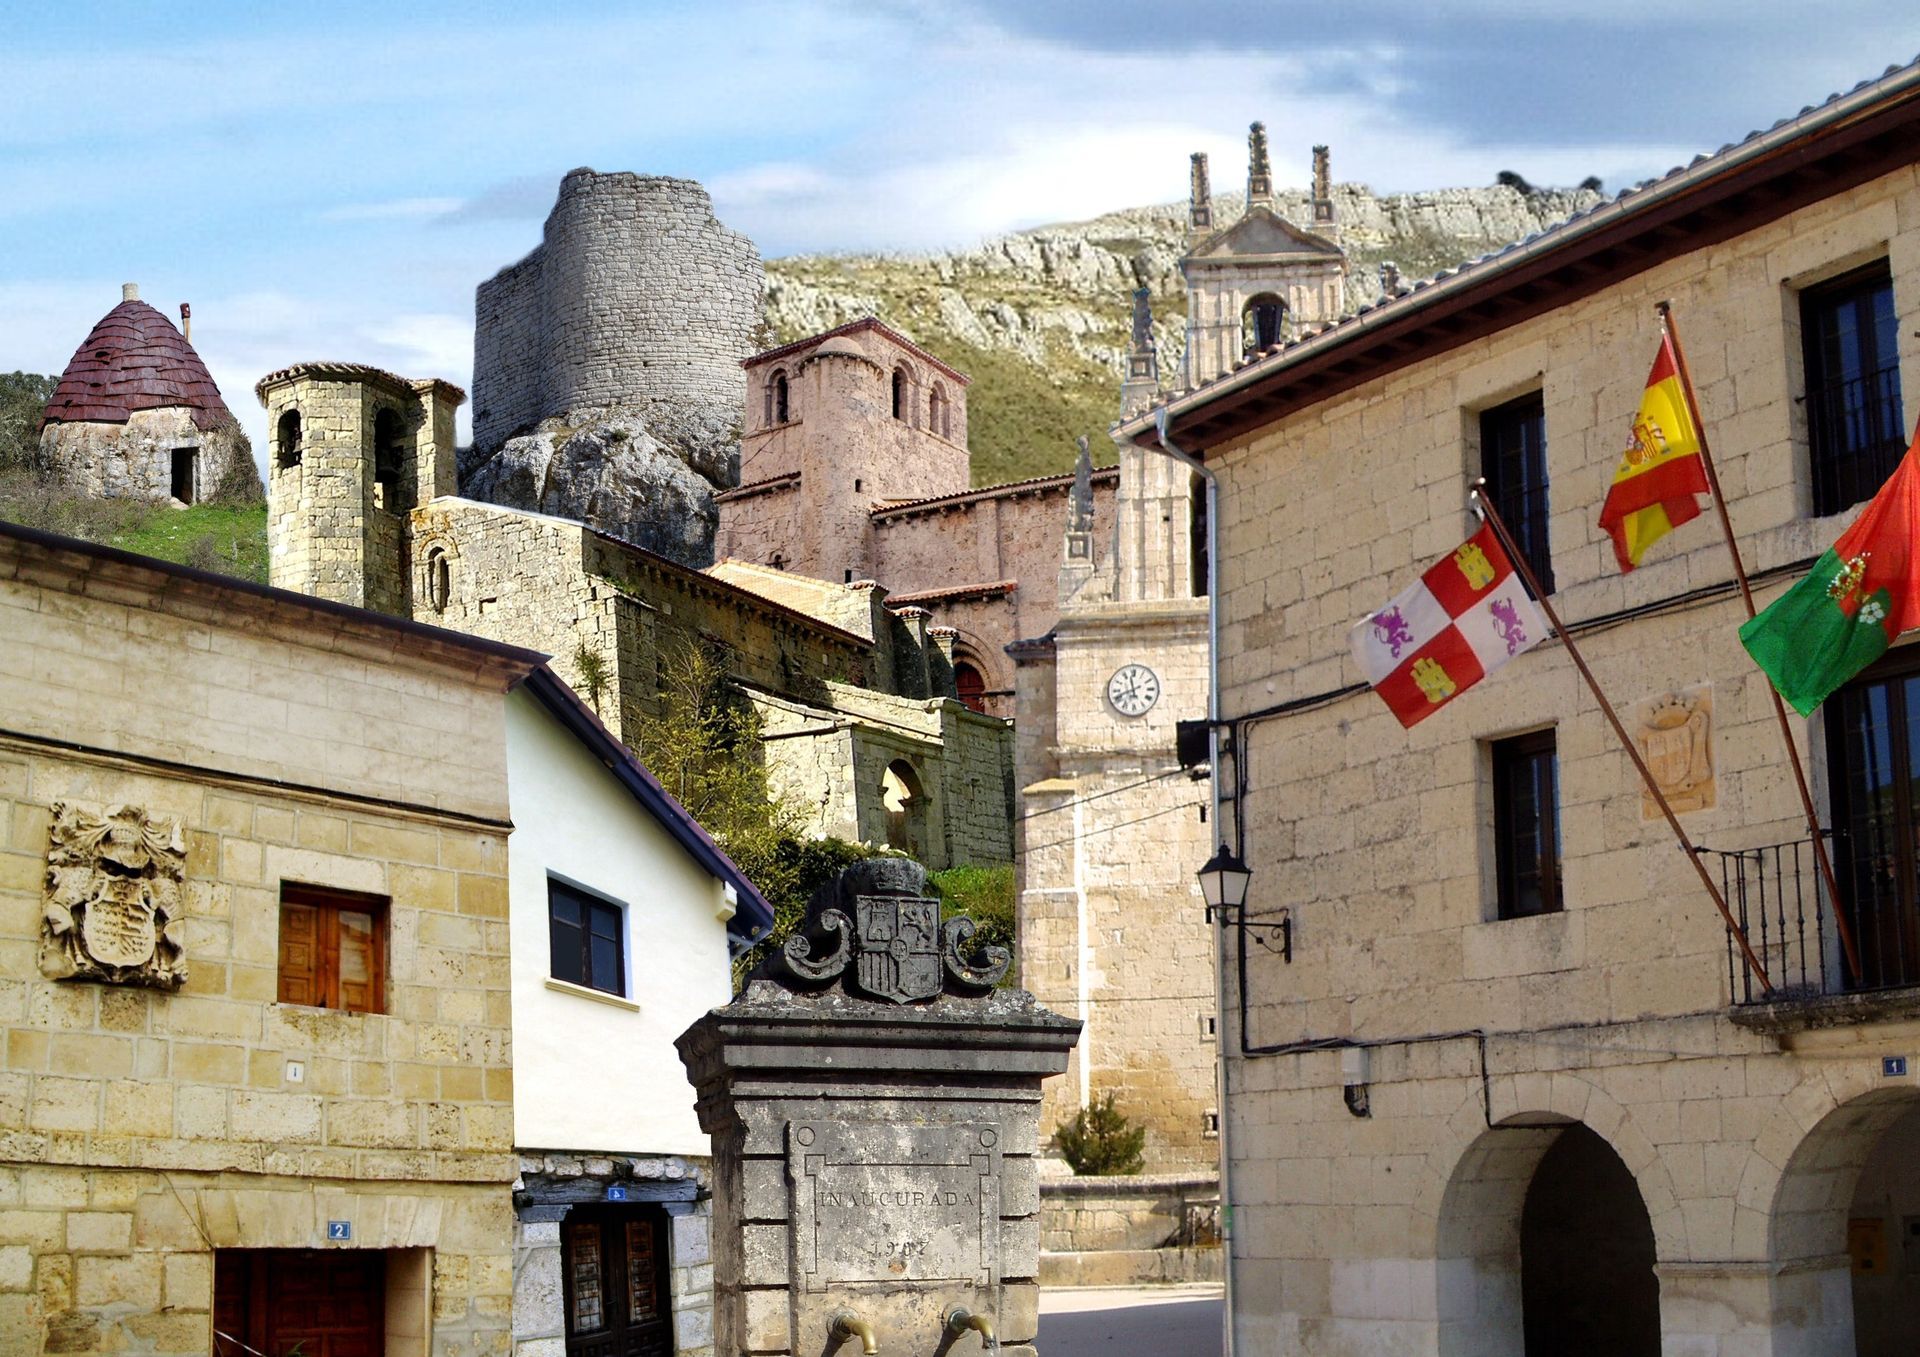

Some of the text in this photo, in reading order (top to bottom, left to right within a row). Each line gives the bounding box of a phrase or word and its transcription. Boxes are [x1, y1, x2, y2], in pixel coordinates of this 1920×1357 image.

[1891, 1060, 1898, 1073] 1
[820, 1191, 974, 1207] INAUGURADA
[335, 1224, 344, 1237] 2
